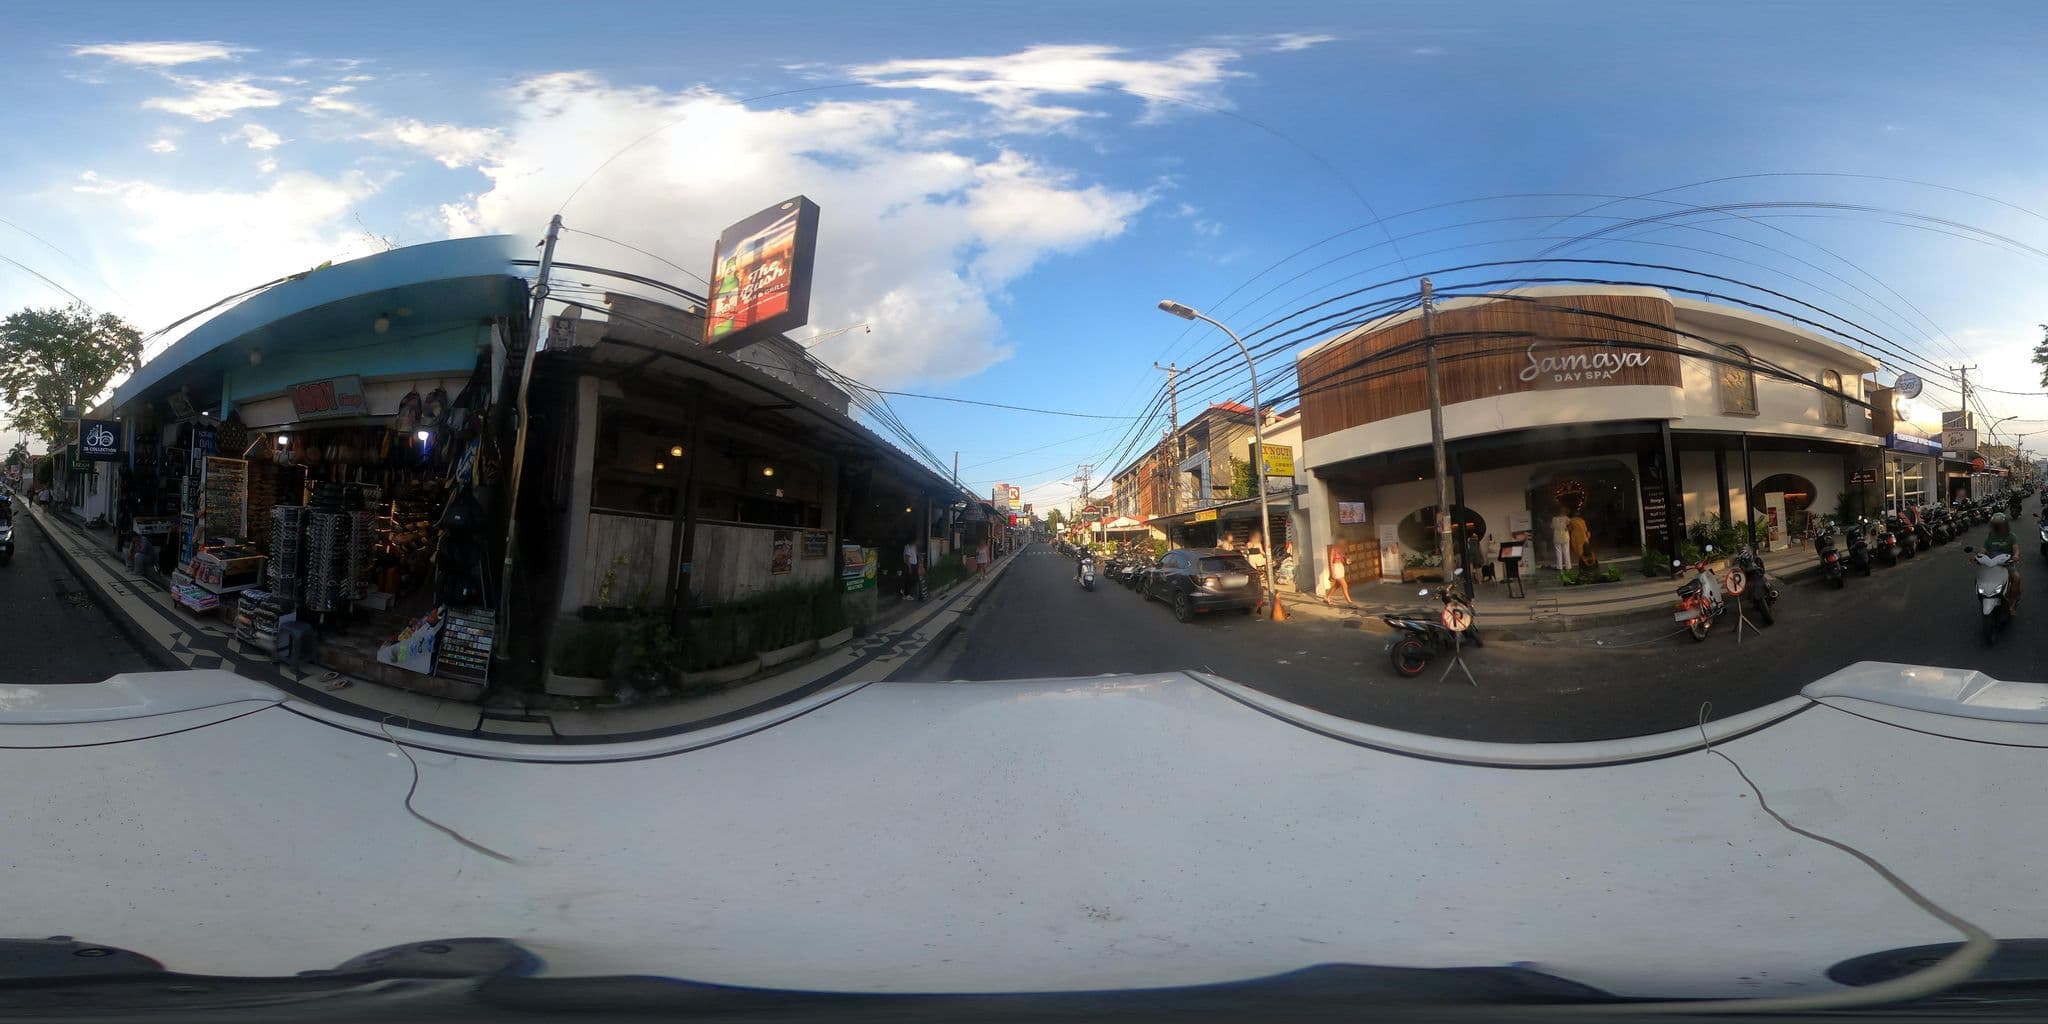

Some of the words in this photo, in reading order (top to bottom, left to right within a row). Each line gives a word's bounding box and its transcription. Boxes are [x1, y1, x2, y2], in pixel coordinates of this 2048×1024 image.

[748, 260, 781, 283] The
[740, 267, 787, 301] Bush
[1519, 342, 1651, 382] Samaya
[1554, 372, 1582, 383] DAY
[1585, 370, 1612, 380] SPA
[1733, 573, 1742, 592] P
[1452, 608, 1464, 628] P
